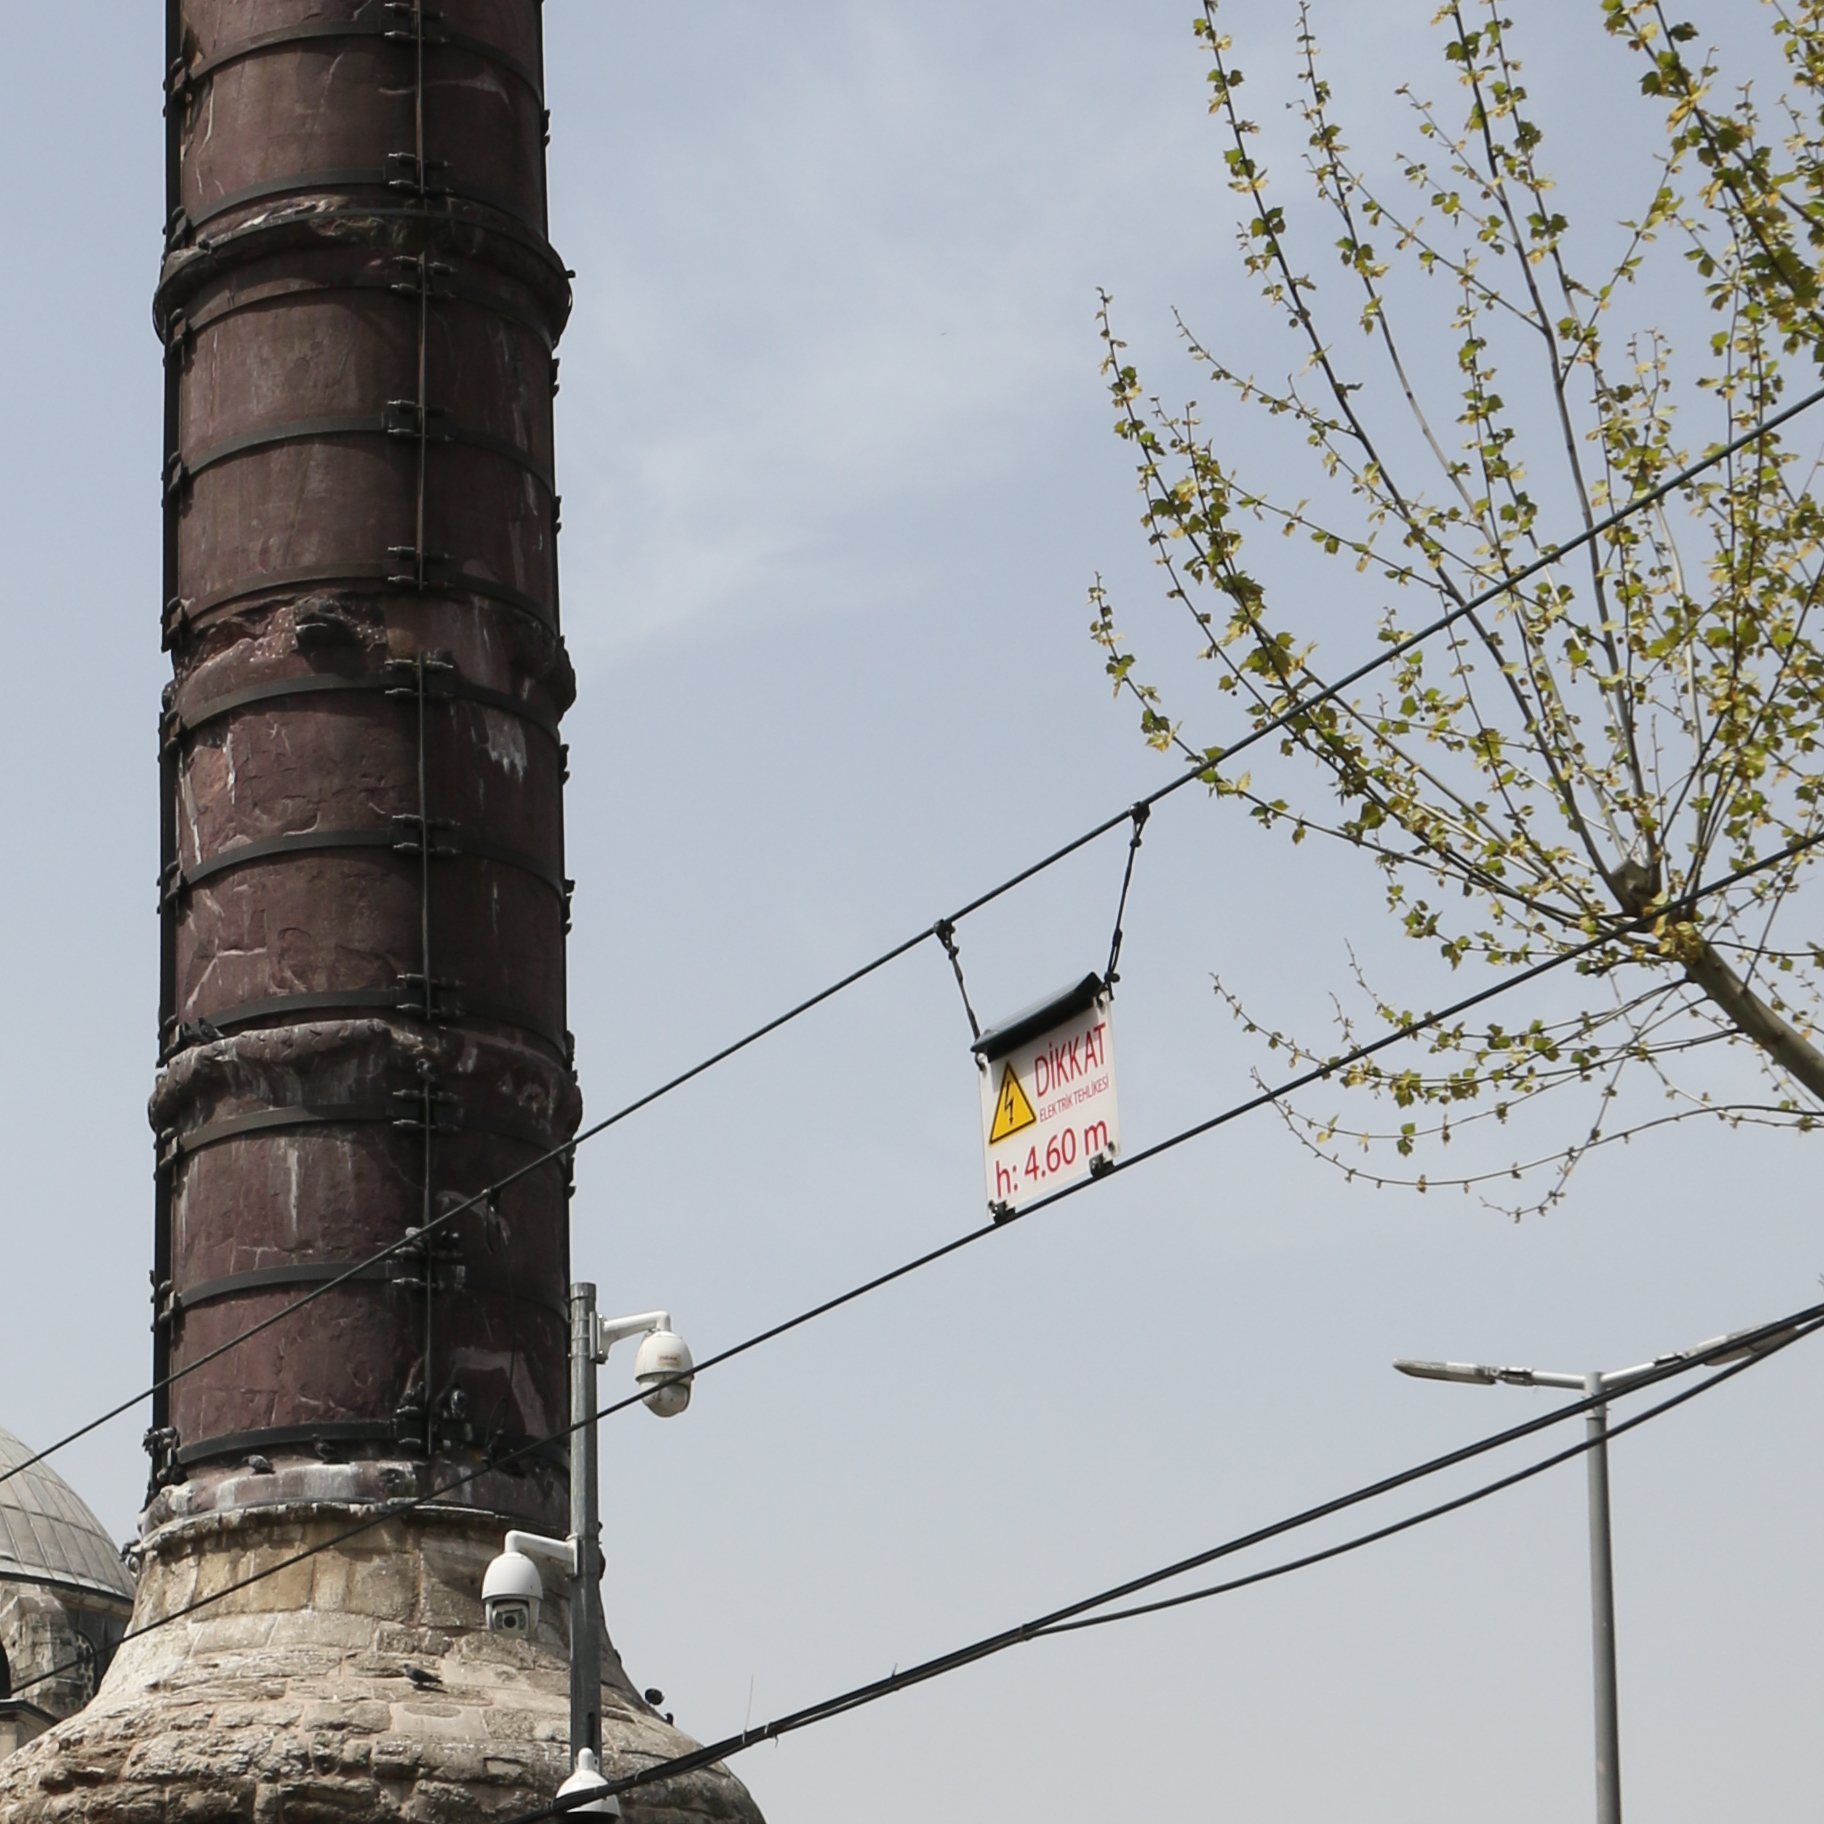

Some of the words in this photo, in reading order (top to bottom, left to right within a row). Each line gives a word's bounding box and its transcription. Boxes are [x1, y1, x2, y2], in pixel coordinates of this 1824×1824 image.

[1034, 1022, 1106, 1098] DİKKAT
[1039, 1093, 1074, 1123] ELEKTRİK
[1073, 1072, 1110, 1104] TEHLİKESİ
[995, 1160, 1018, 1198] h:
[1024, 1127, 1077, 1181] 4.60
[1084, 1120, 1108, 1155] m
